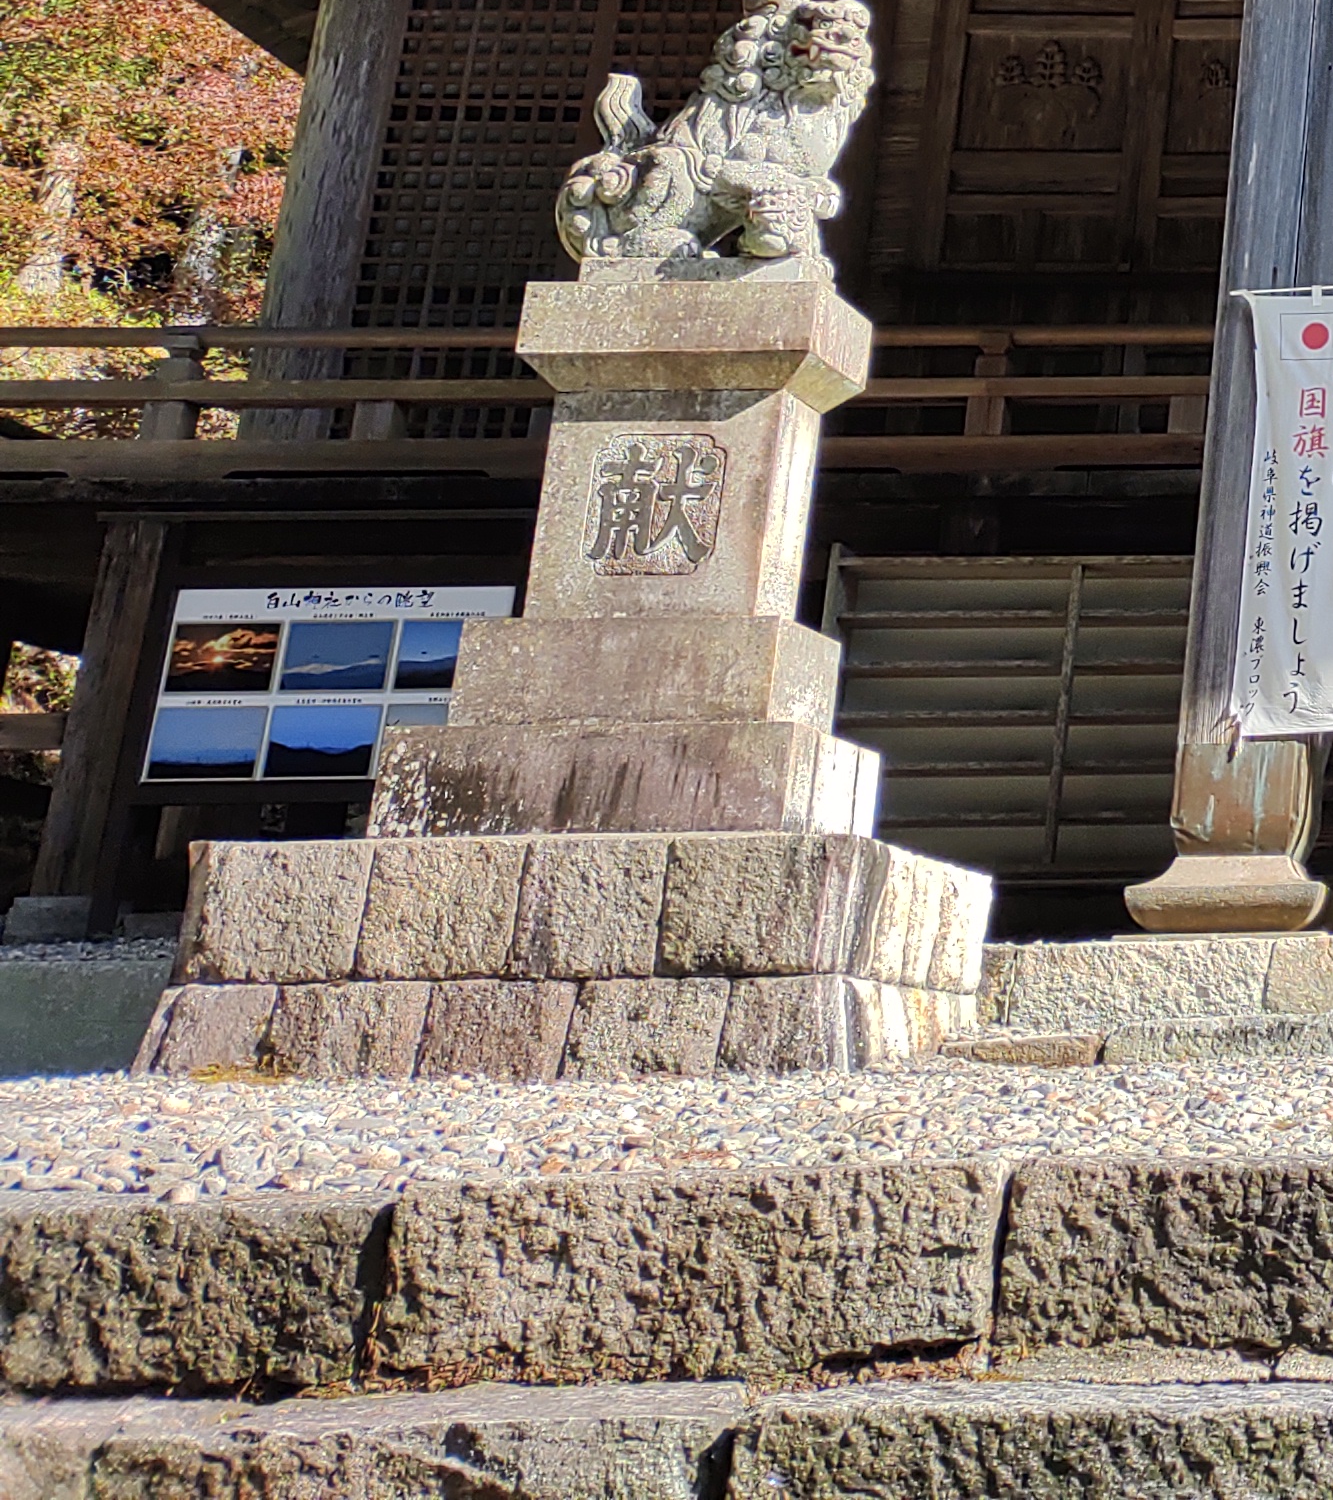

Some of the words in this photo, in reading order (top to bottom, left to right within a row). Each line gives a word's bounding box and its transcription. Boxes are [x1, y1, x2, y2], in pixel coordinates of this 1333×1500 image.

[585, 443, 718, 564] 献
[1253, 448, 1280, 597] 岐阜県神道振興会
[1282, 387, 1330, 714] 国旗を掲げましょう
